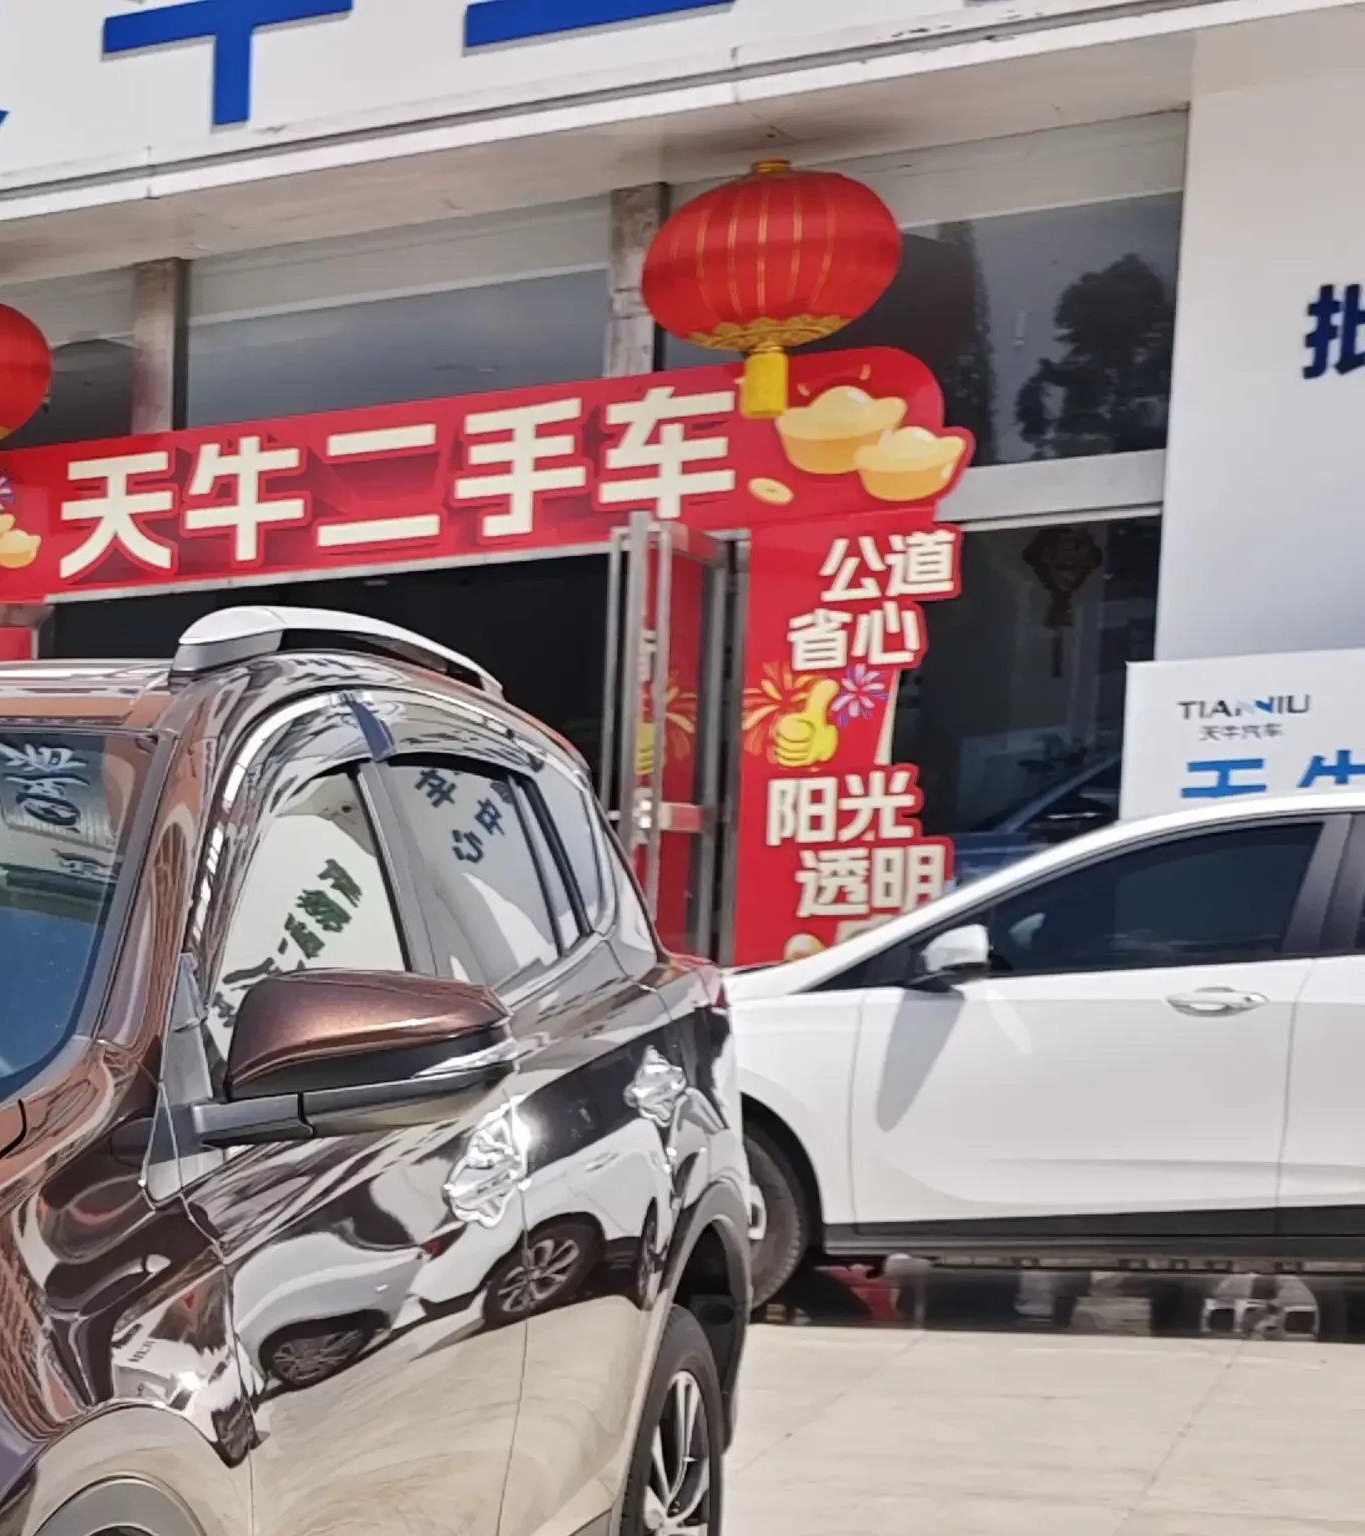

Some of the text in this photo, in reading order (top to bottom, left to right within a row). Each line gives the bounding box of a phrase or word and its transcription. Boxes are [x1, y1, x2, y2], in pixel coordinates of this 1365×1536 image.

[58, 385, 737, 582] 天牛二手车
[819, 529, 956, 602] 公道
[786, 600, 921, 671] 省心
[765, 769, 917, 846] 阳光
[794, 843, 946, 917] 透明
